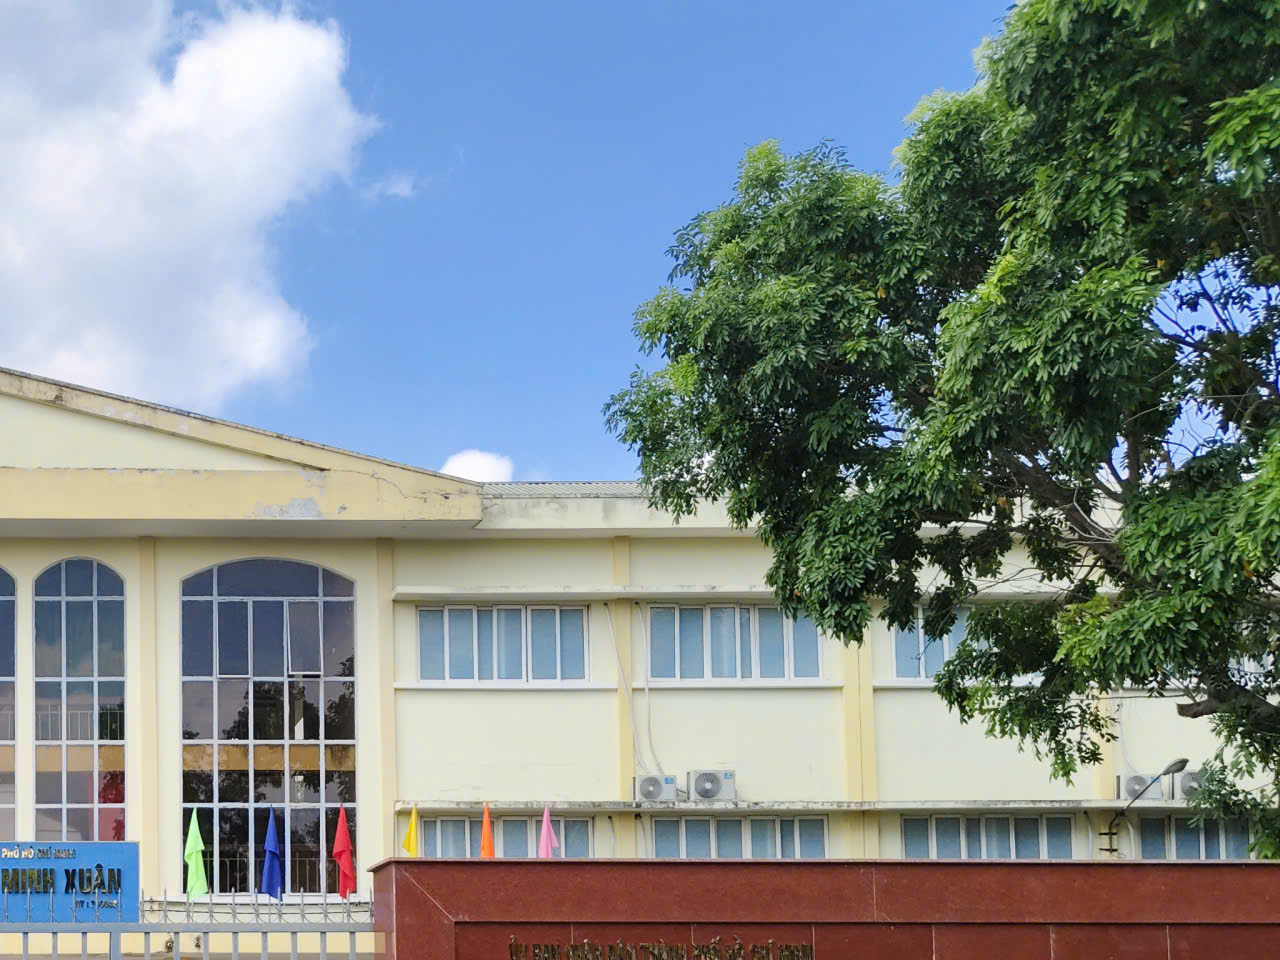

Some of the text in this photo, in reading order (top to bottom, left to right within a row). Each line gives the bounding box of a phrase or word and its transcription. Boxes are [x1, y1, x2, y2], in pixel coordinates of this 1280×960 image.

[1, 844, 19, 859] PHỐ
[21, 845, 35, 859] HỒ
[37, 846, 52, 859] CHÍ
[1, 868, 55, 894] MINH
[64, 863, 121, 894] XUÂN
